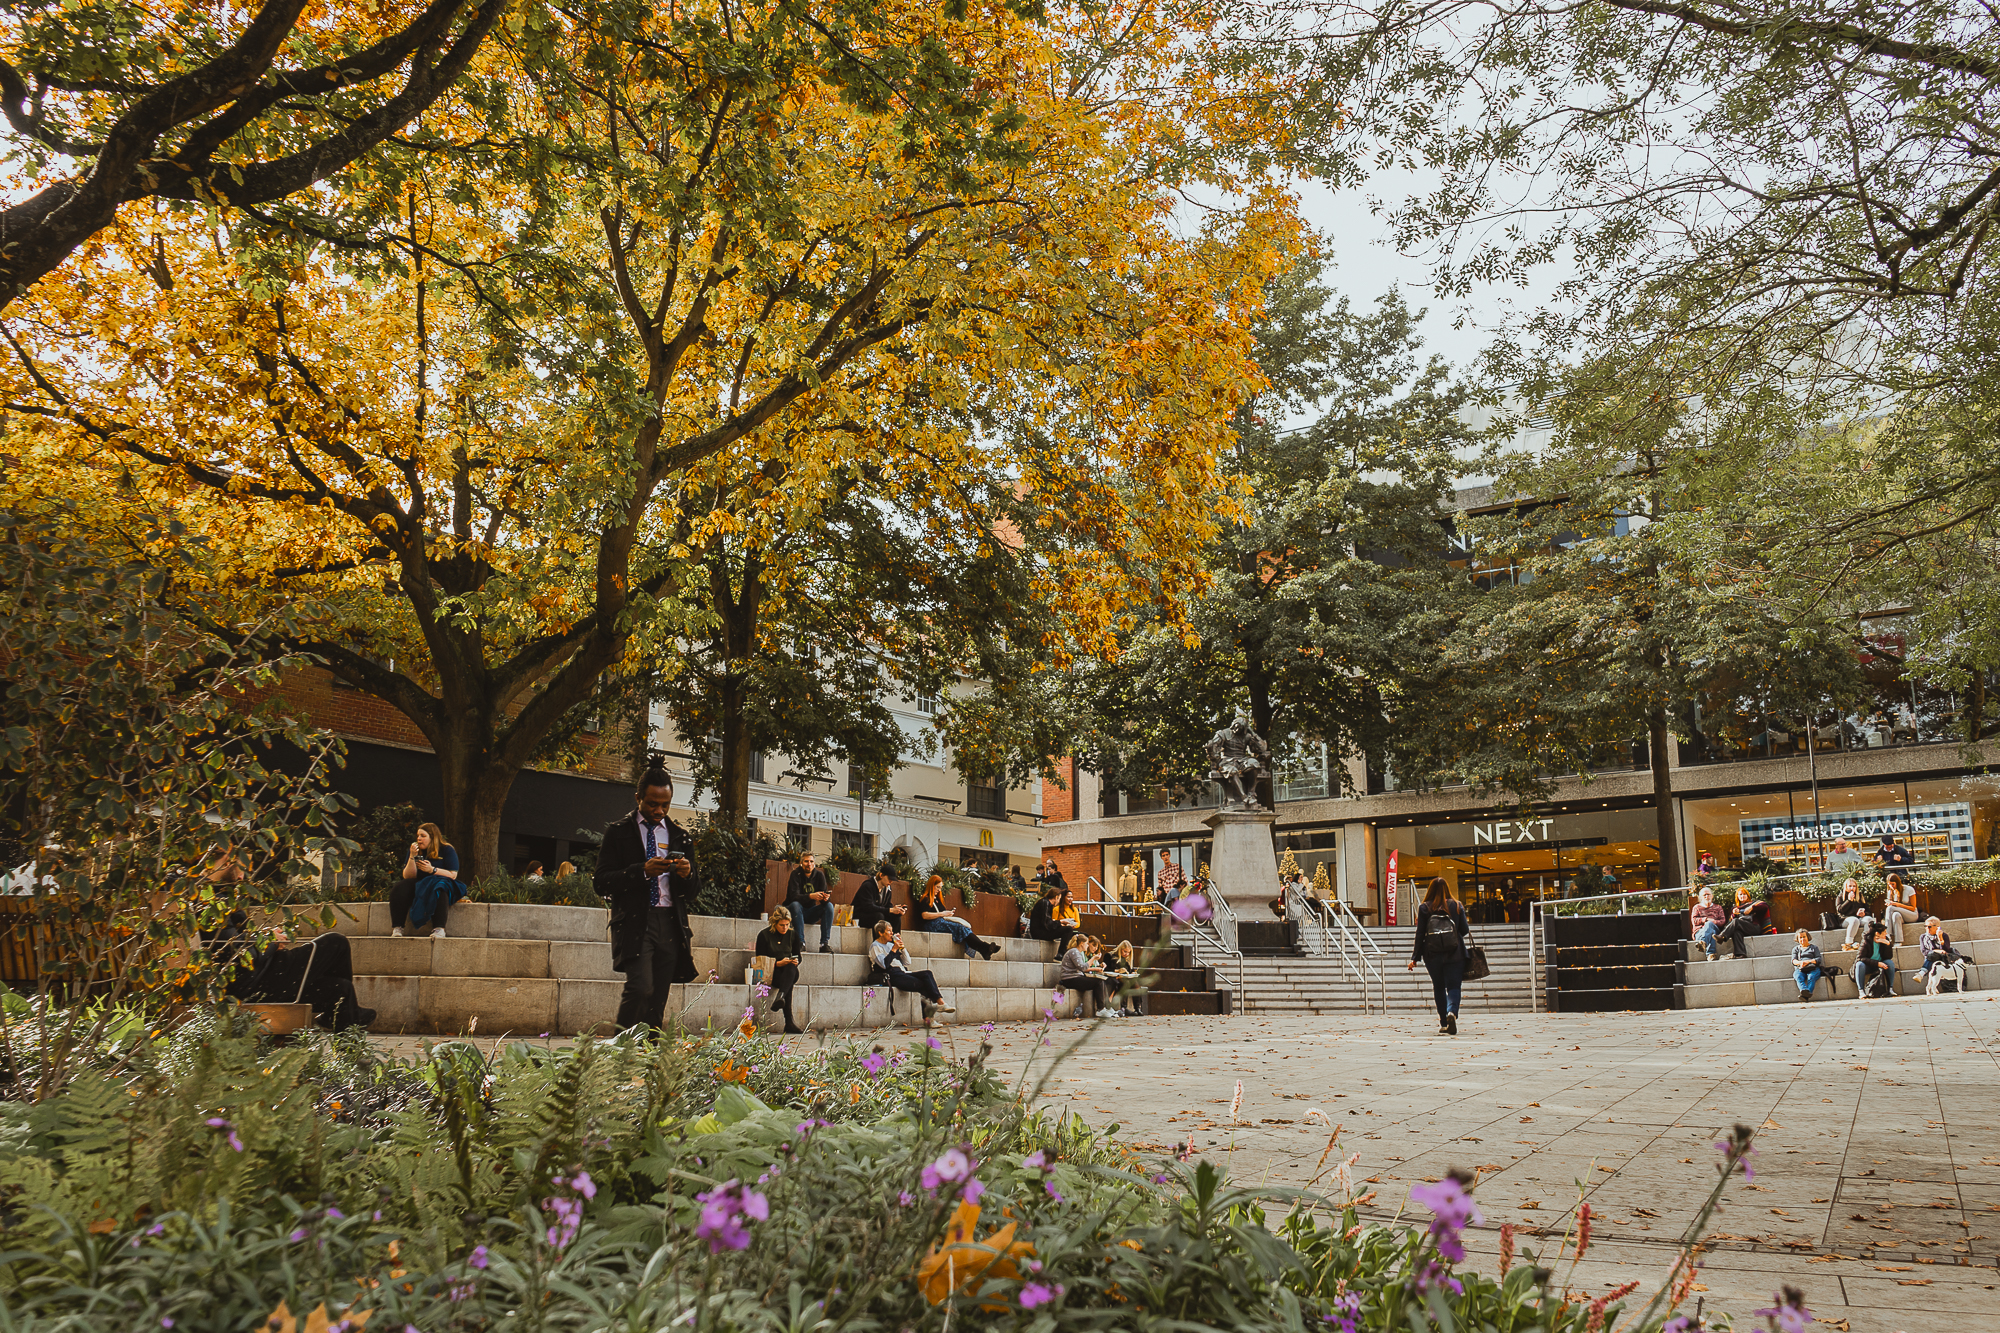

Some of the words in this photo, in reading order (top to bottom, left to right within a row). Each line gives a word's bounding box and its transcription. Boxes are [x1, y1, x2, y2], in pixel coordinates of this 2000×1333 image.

[762, 799, 852, 828] McDonald's
[1473, 818, 1554, 845] NEXT
[1771, 825, 1813, 842] Bath
[1814, 824, 1829, 839] &
[1830, 821, 1876, 838] Body
